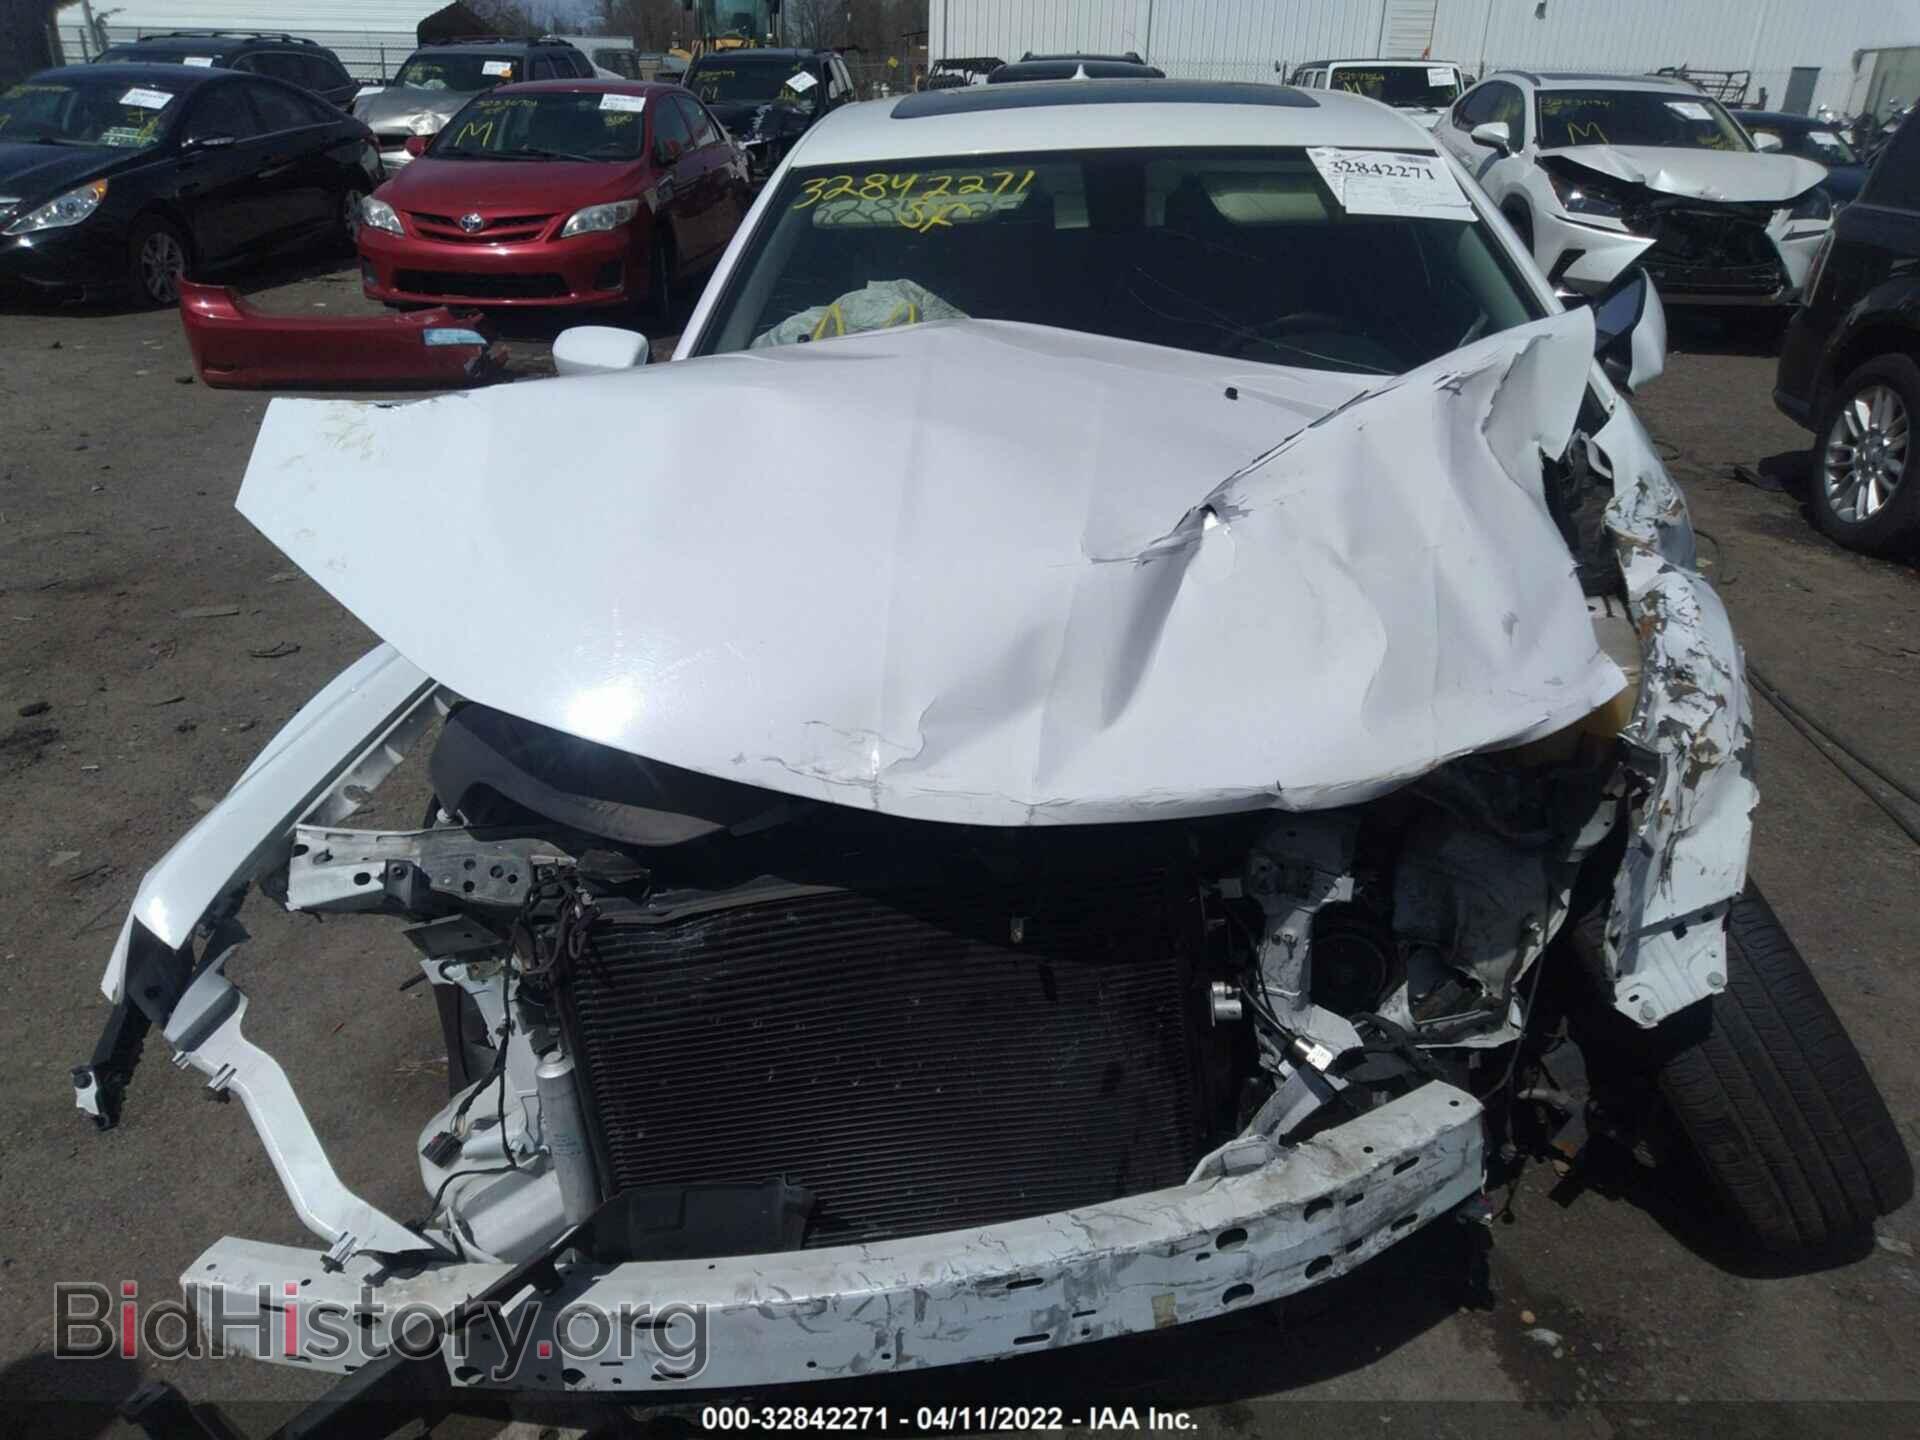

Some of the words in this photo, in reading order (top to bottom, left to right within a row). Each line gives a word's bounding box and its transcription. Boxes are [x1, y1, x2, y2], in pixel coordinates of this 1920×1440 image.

[455, 120, 494, 148] M
[1567, 121, 1609, 145] M
[1329, 160, 1435, 180] 32842271
[793, 169, 1036, 209] 32842271
